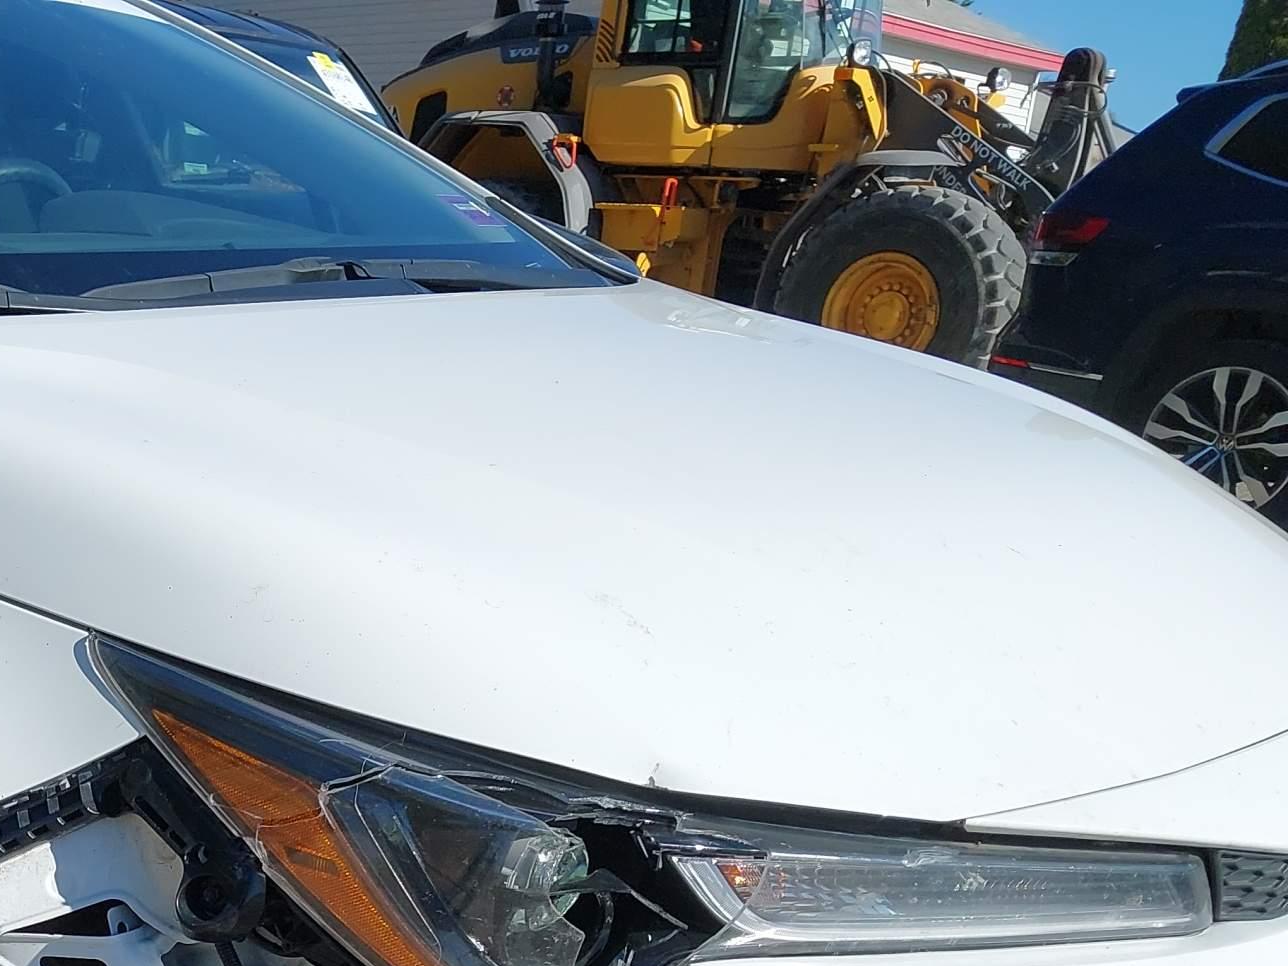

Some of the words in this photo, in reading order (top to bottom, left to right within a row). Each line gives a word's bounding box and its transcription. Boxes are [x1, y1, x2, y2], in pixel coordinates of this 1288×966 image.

[509, 44, 569, 58] VOLO
[952, 125, 971, 144] DO
[970, 140, 999, 164] NOT
[997, 159, 1031, 191] WALK
